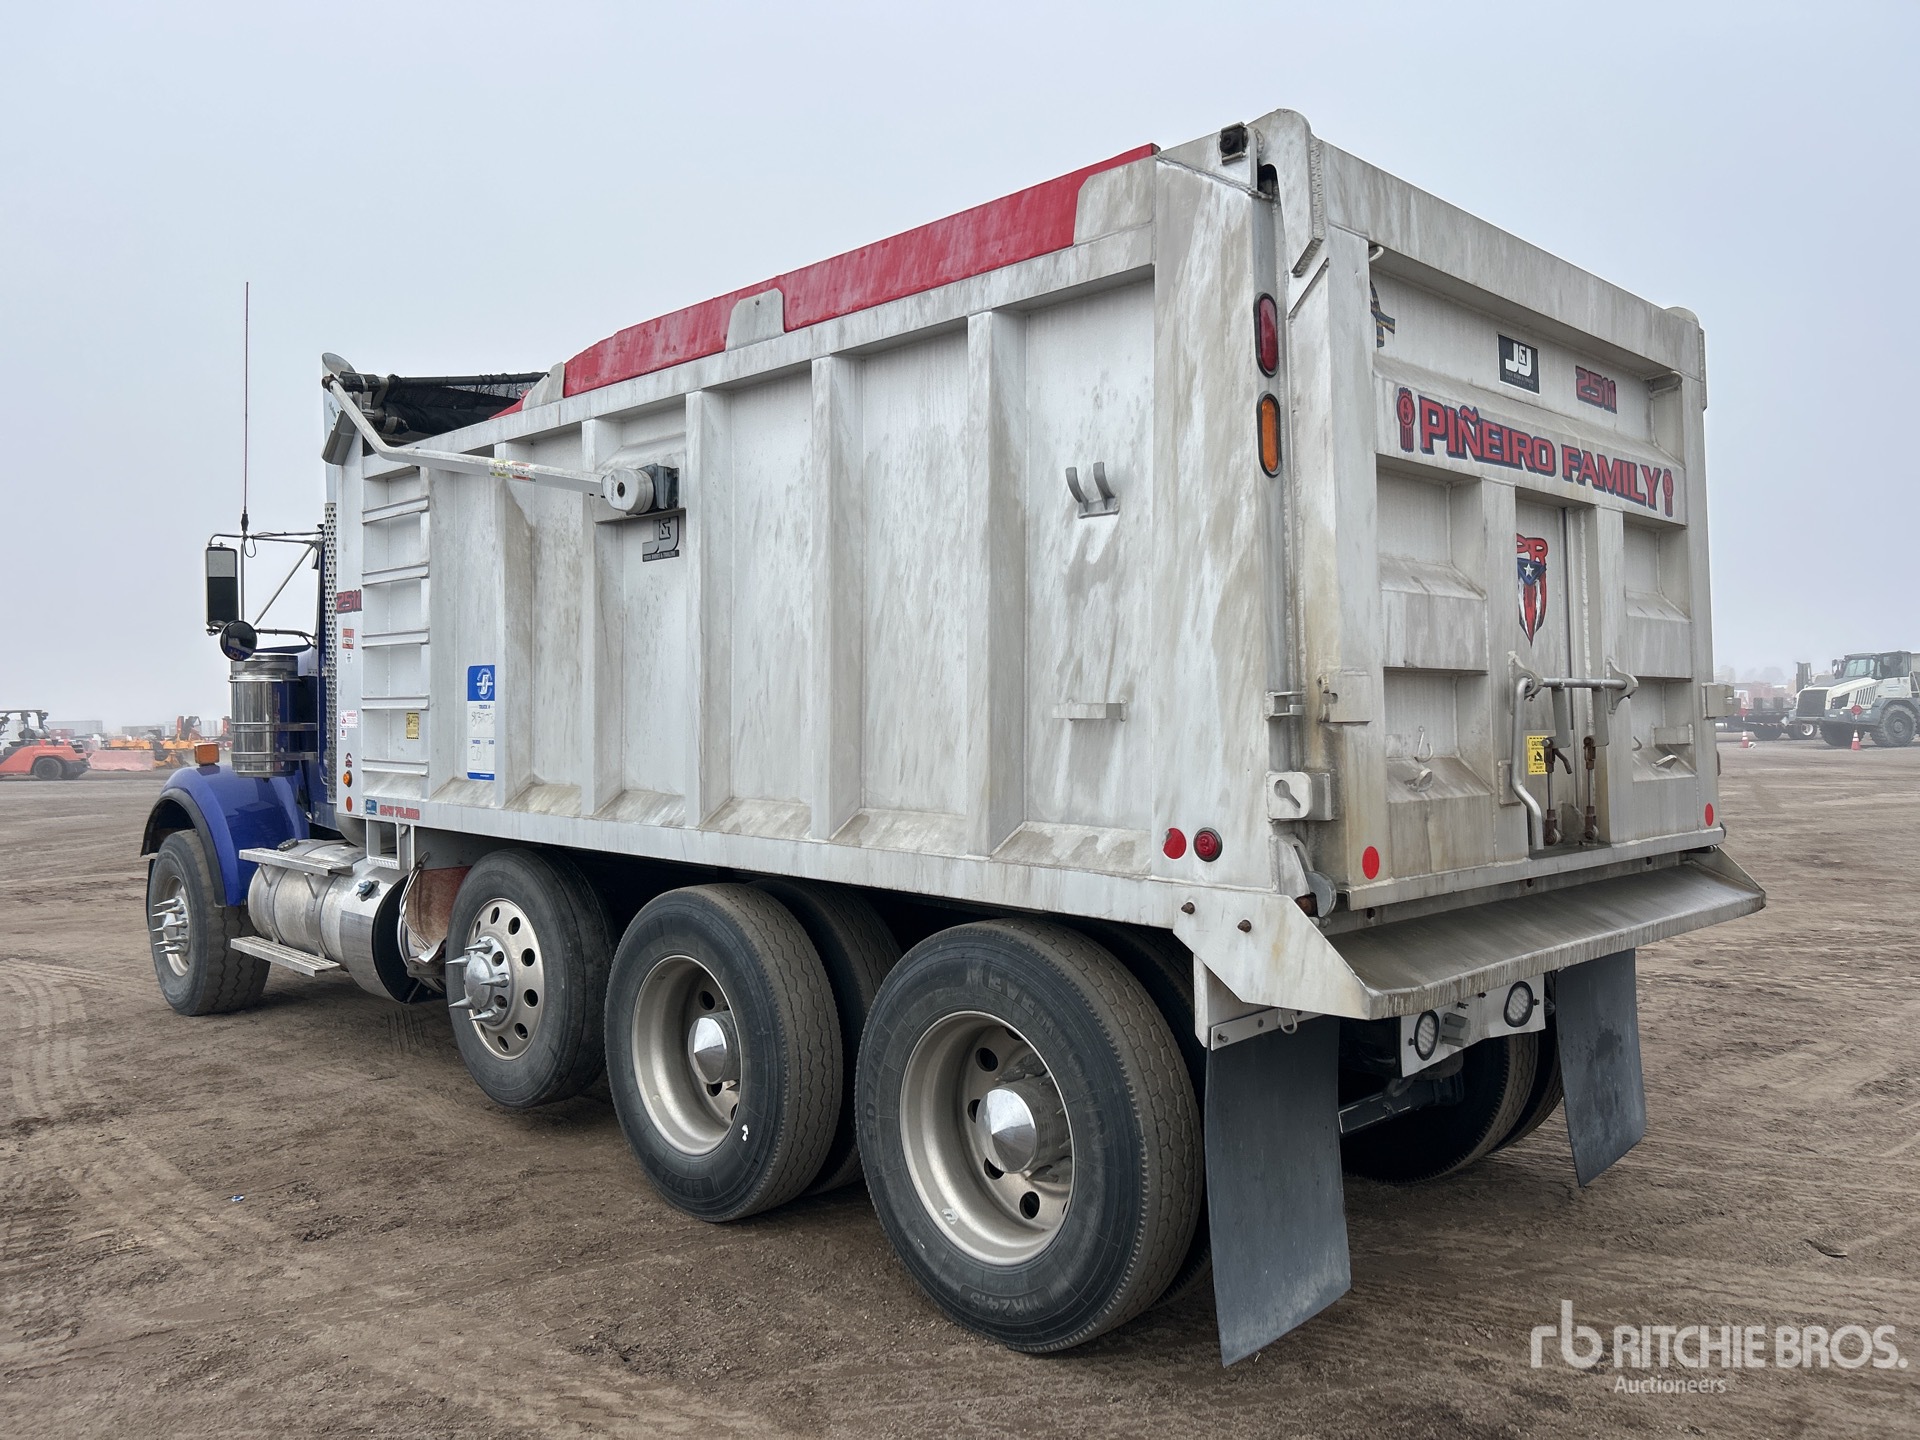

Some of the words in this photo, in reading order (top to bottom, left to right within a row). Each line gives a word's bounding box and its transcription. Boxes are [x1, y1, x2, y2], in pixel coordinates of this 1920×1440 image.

[1505, 342, 1532, 376] J&J
[1576, 365, 1617, 414] 2511
[1418, 395, 1556, 477] PIÑEIRO
[1561, 444, 1662, 511] FAMILY
[336, 588, 362, 614] 2511
